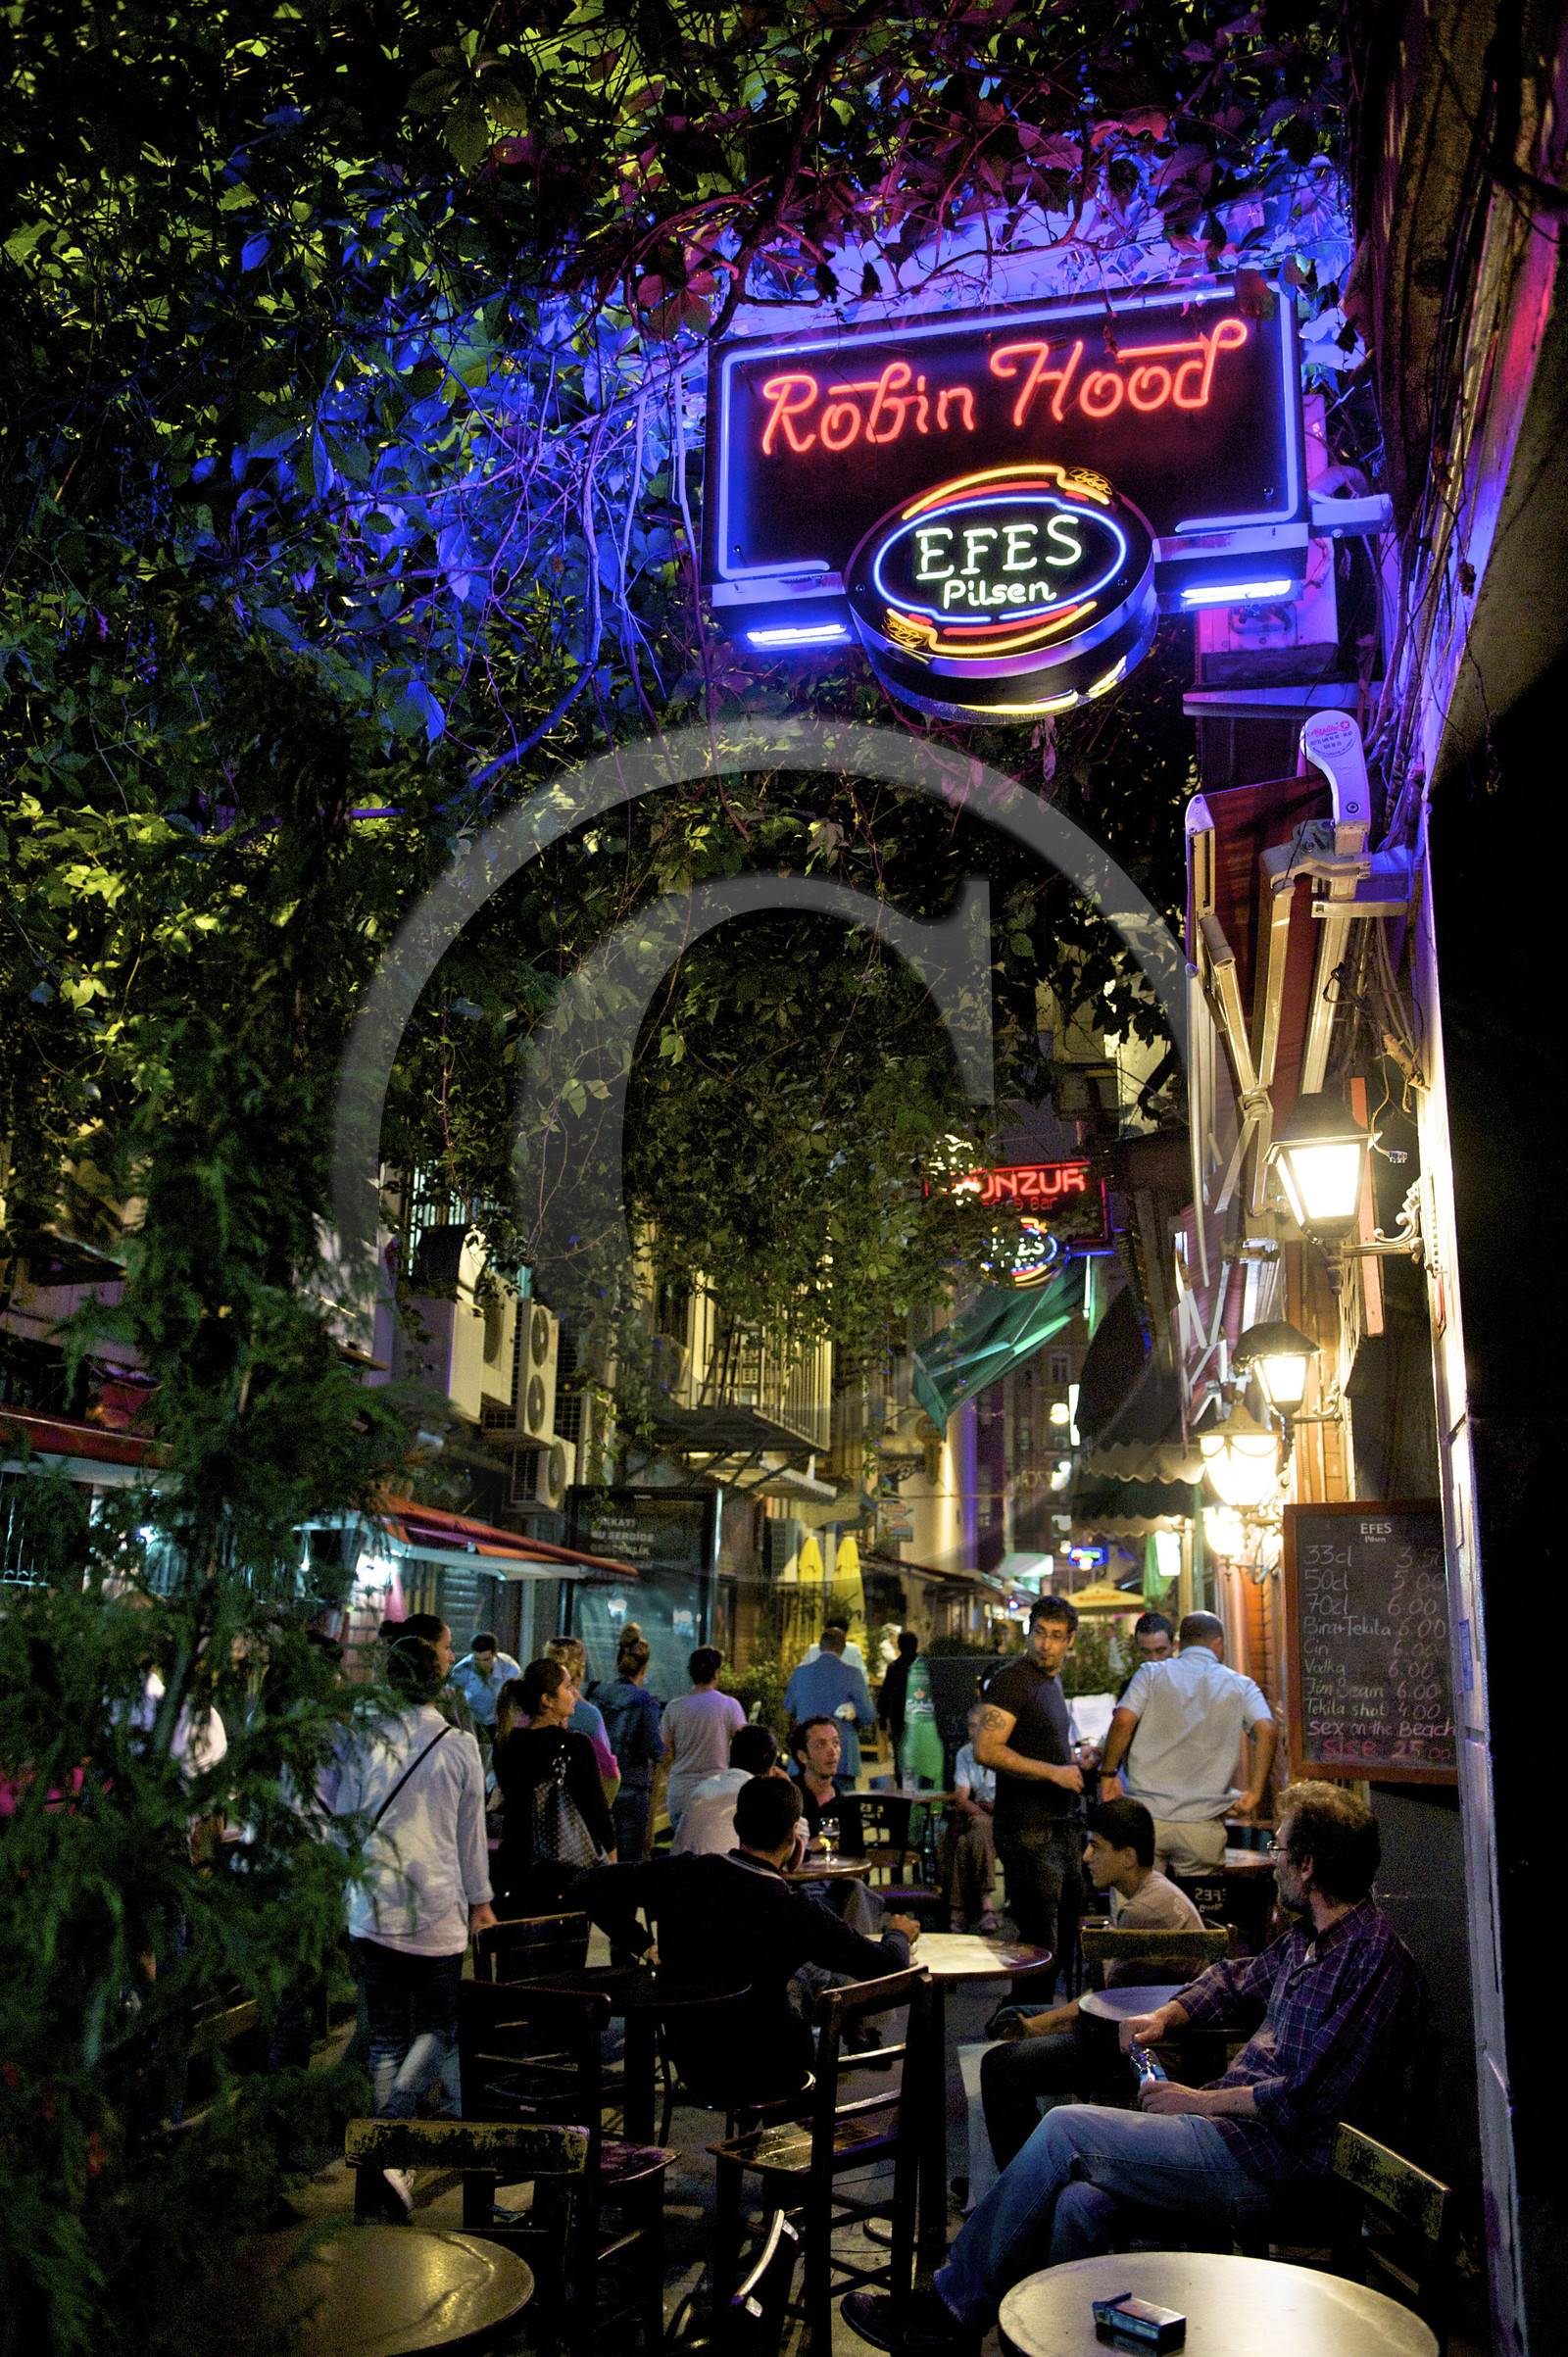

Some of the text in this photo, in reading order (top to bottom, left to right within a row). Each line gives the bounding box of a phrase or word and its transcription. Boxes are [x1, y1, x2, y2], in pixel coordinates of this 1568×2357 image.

[762, 319, 1249, 455] Robin Hood
[914, 514, 1083, 580] EFES
[943, 579, 1057, 610] Pilsen
[1030, 1195, 1059, 1211] Bar
[1359, 1522, 1393, 1535] EFES
[1303, 1545, 1352, 1567] 33cl
[1304, 1569, 1349, 1591] 50cl
[1304, 1594, 1348, 1615] 70cl
[1304, 1657, 1346, 1675] Vodka
[1304, 1677, 1332, 1696] Jim
[1336, 1677, 1384, 1698] Beam
[1304, 1697, 1346, 1715] Tekila
[1352, 1702, 1385, 1717] shot
[1307, 1718, 1456, 1738] Sex on the Beach
